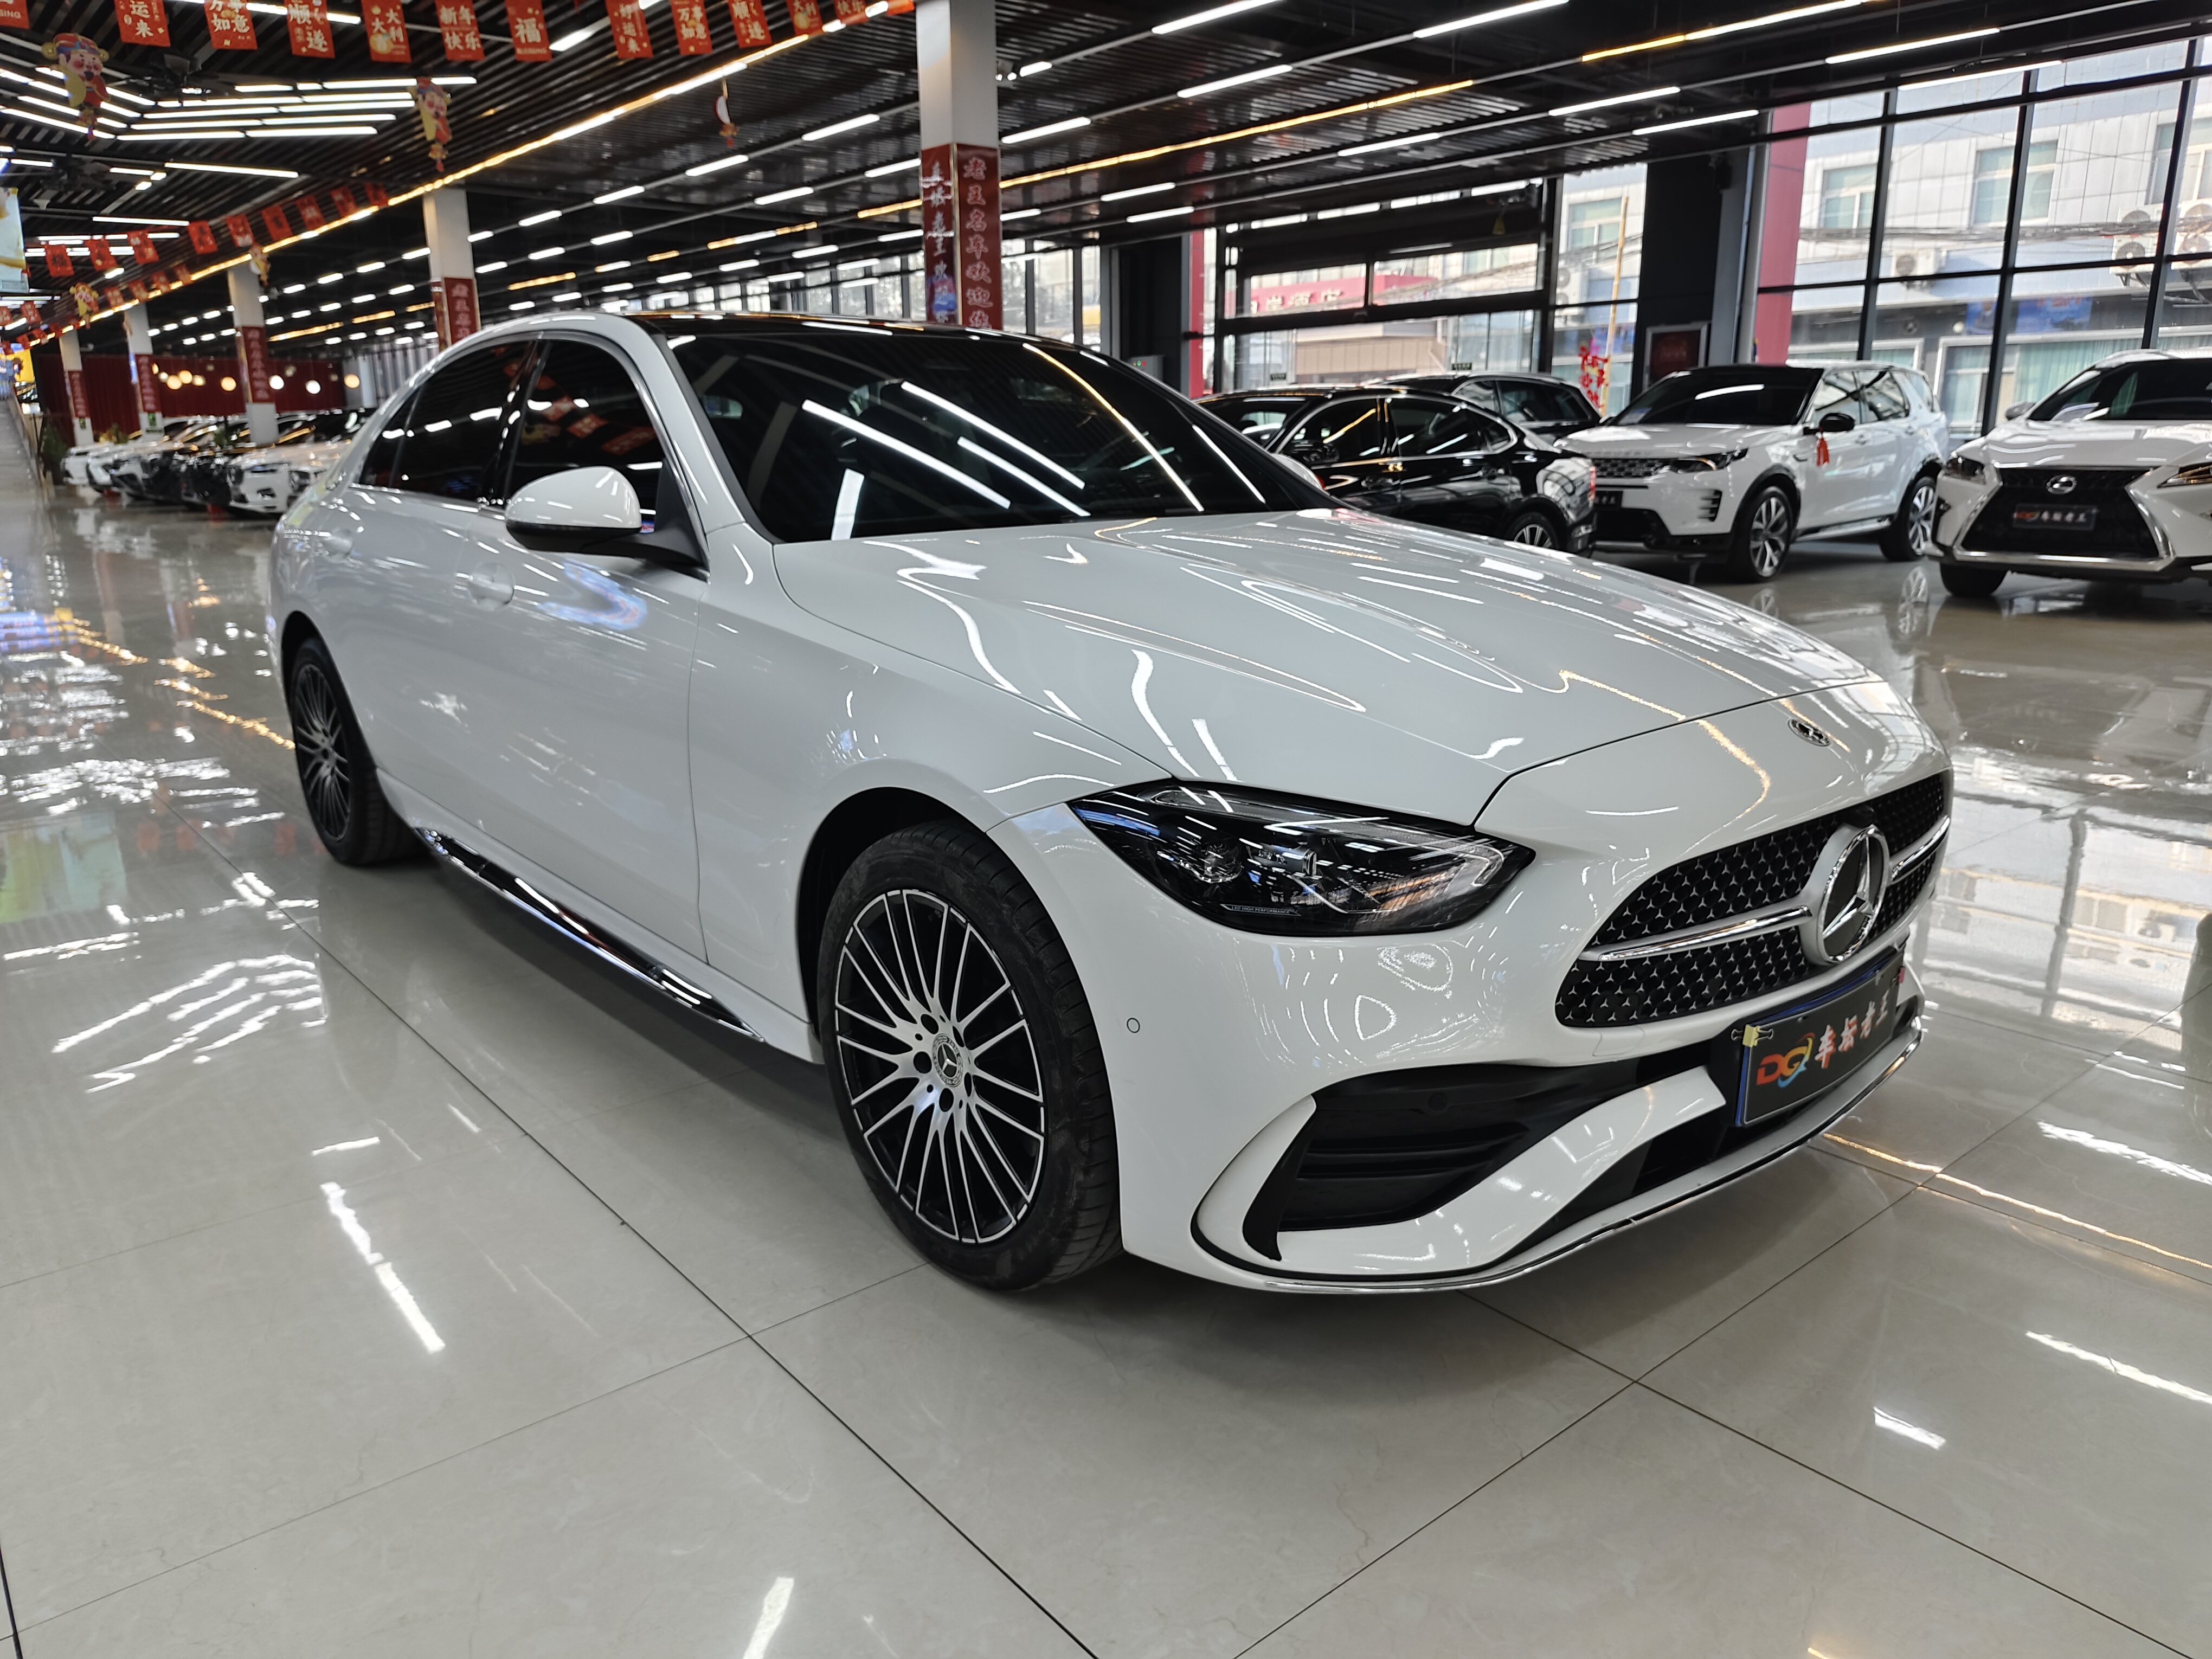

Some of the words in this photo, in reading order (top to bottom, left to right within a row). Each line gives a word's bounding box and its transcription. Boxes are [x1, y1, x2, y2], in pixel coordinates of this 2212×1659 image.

[211, 12, 250, 33] 如意
[440, 5, 475, 25] 新年
[446, 30, 481, 50] 快乐
[515, 17, 541, 43] 福
